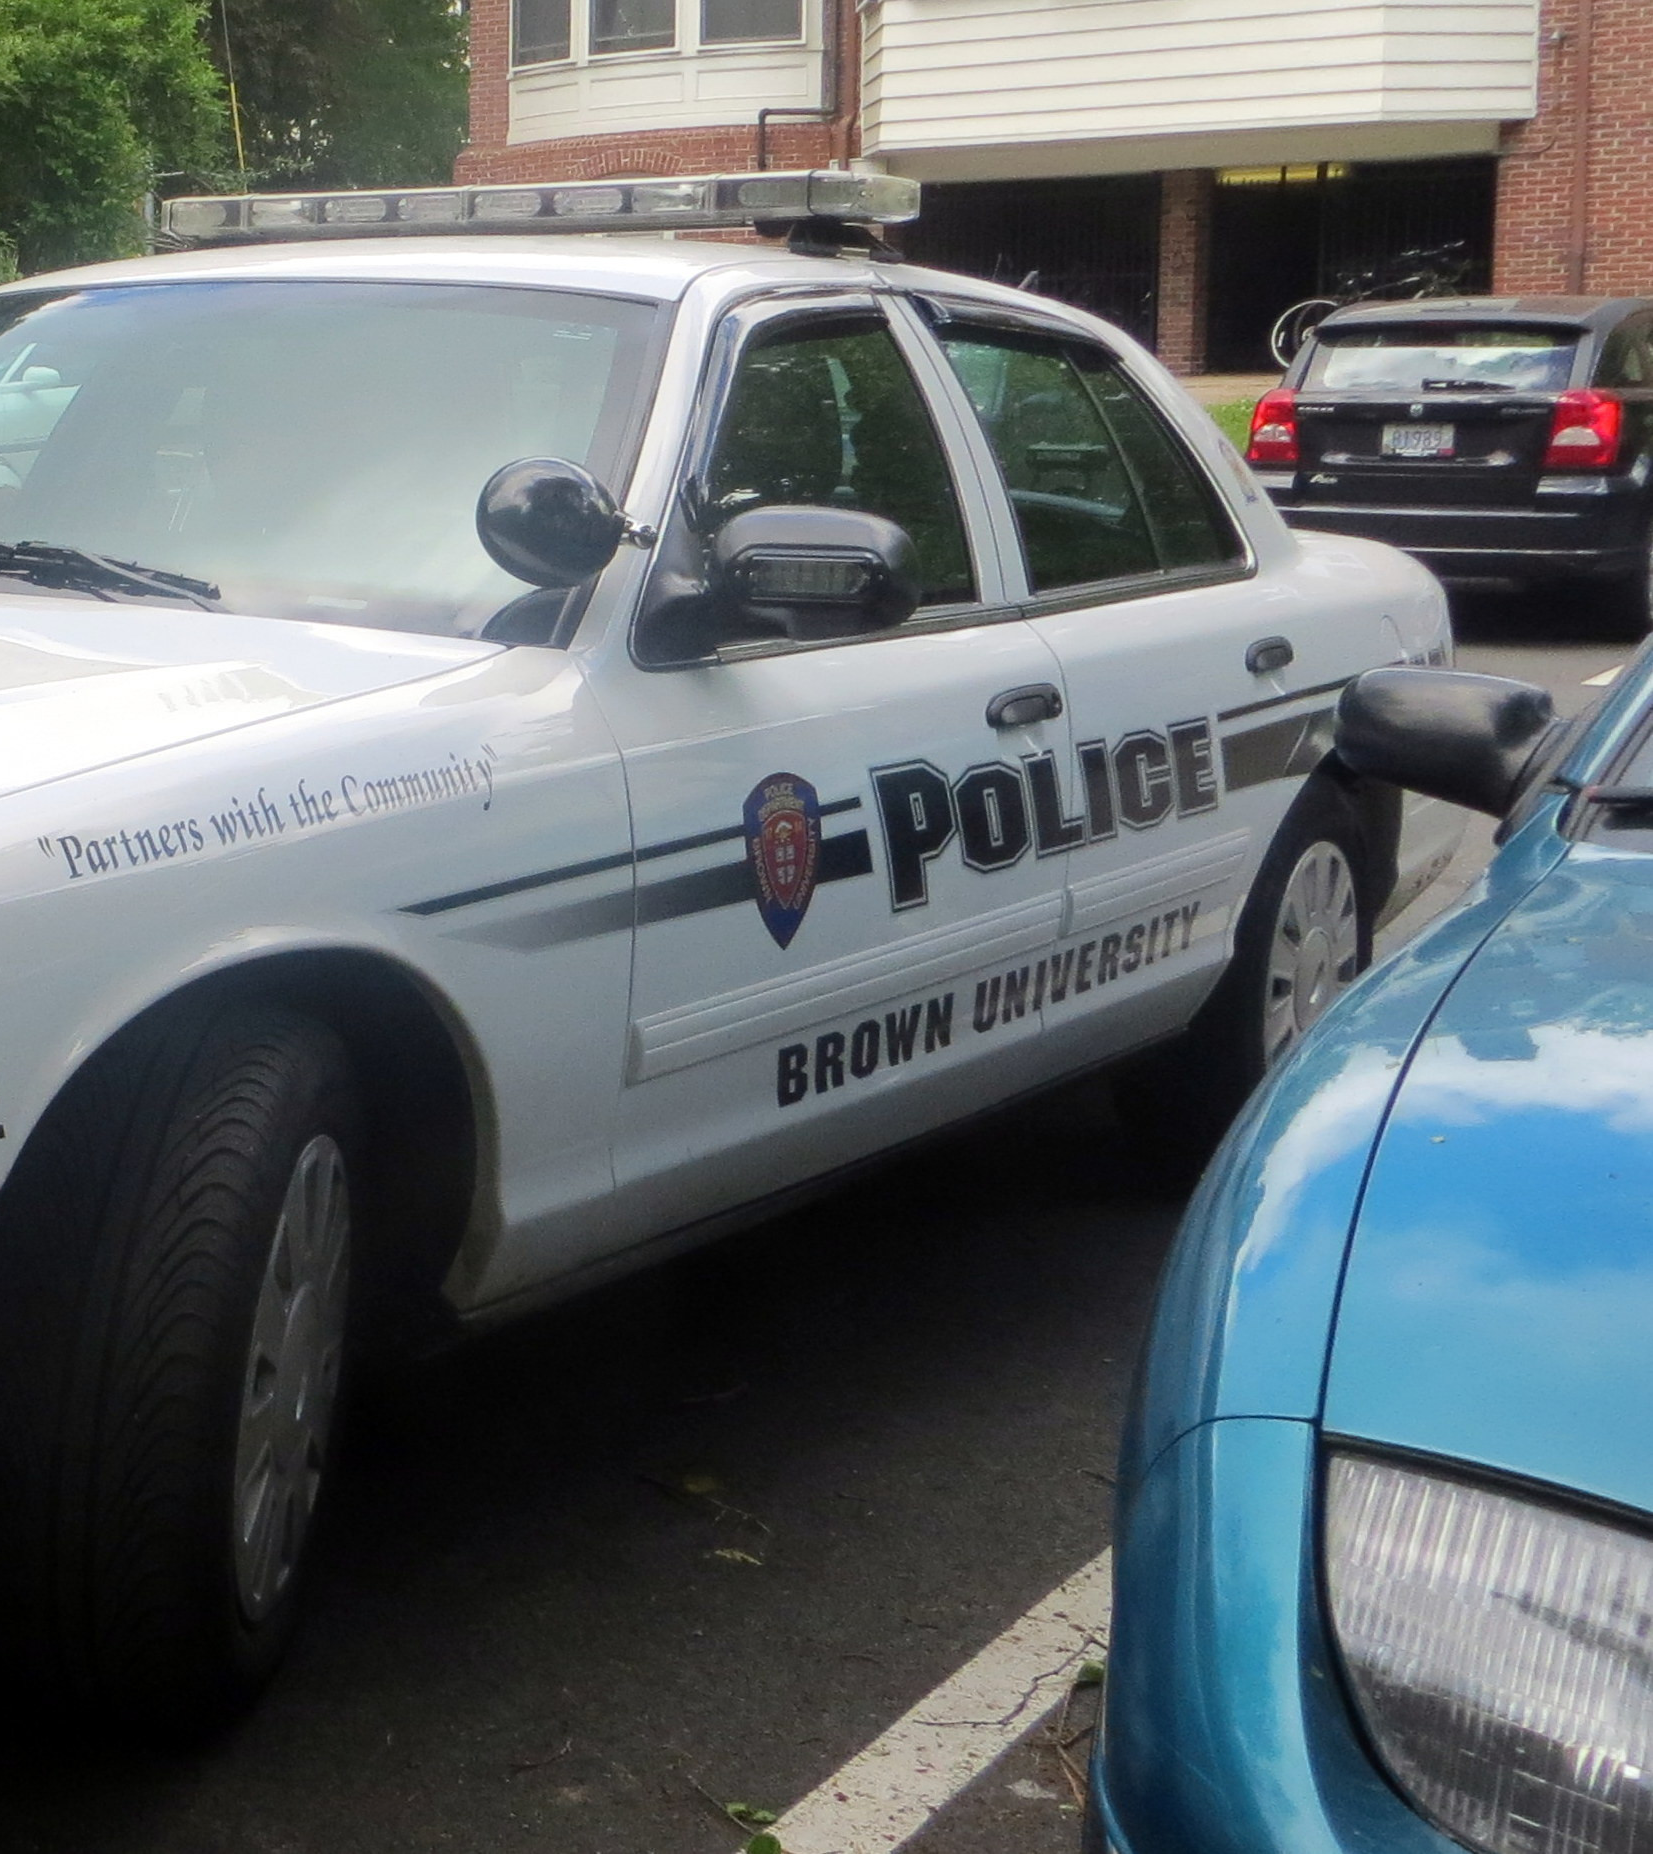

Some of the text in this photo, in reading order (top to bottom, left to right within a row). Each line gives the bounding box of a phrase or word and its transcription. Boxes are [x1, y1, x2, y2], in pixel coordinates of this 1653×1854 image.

[37, 742, 499, 880] "Partners with the Community"
[868, 715, 1219, 914] POLICE
[776, 900, 1202, 1109] BROWN UNIVERSITY
